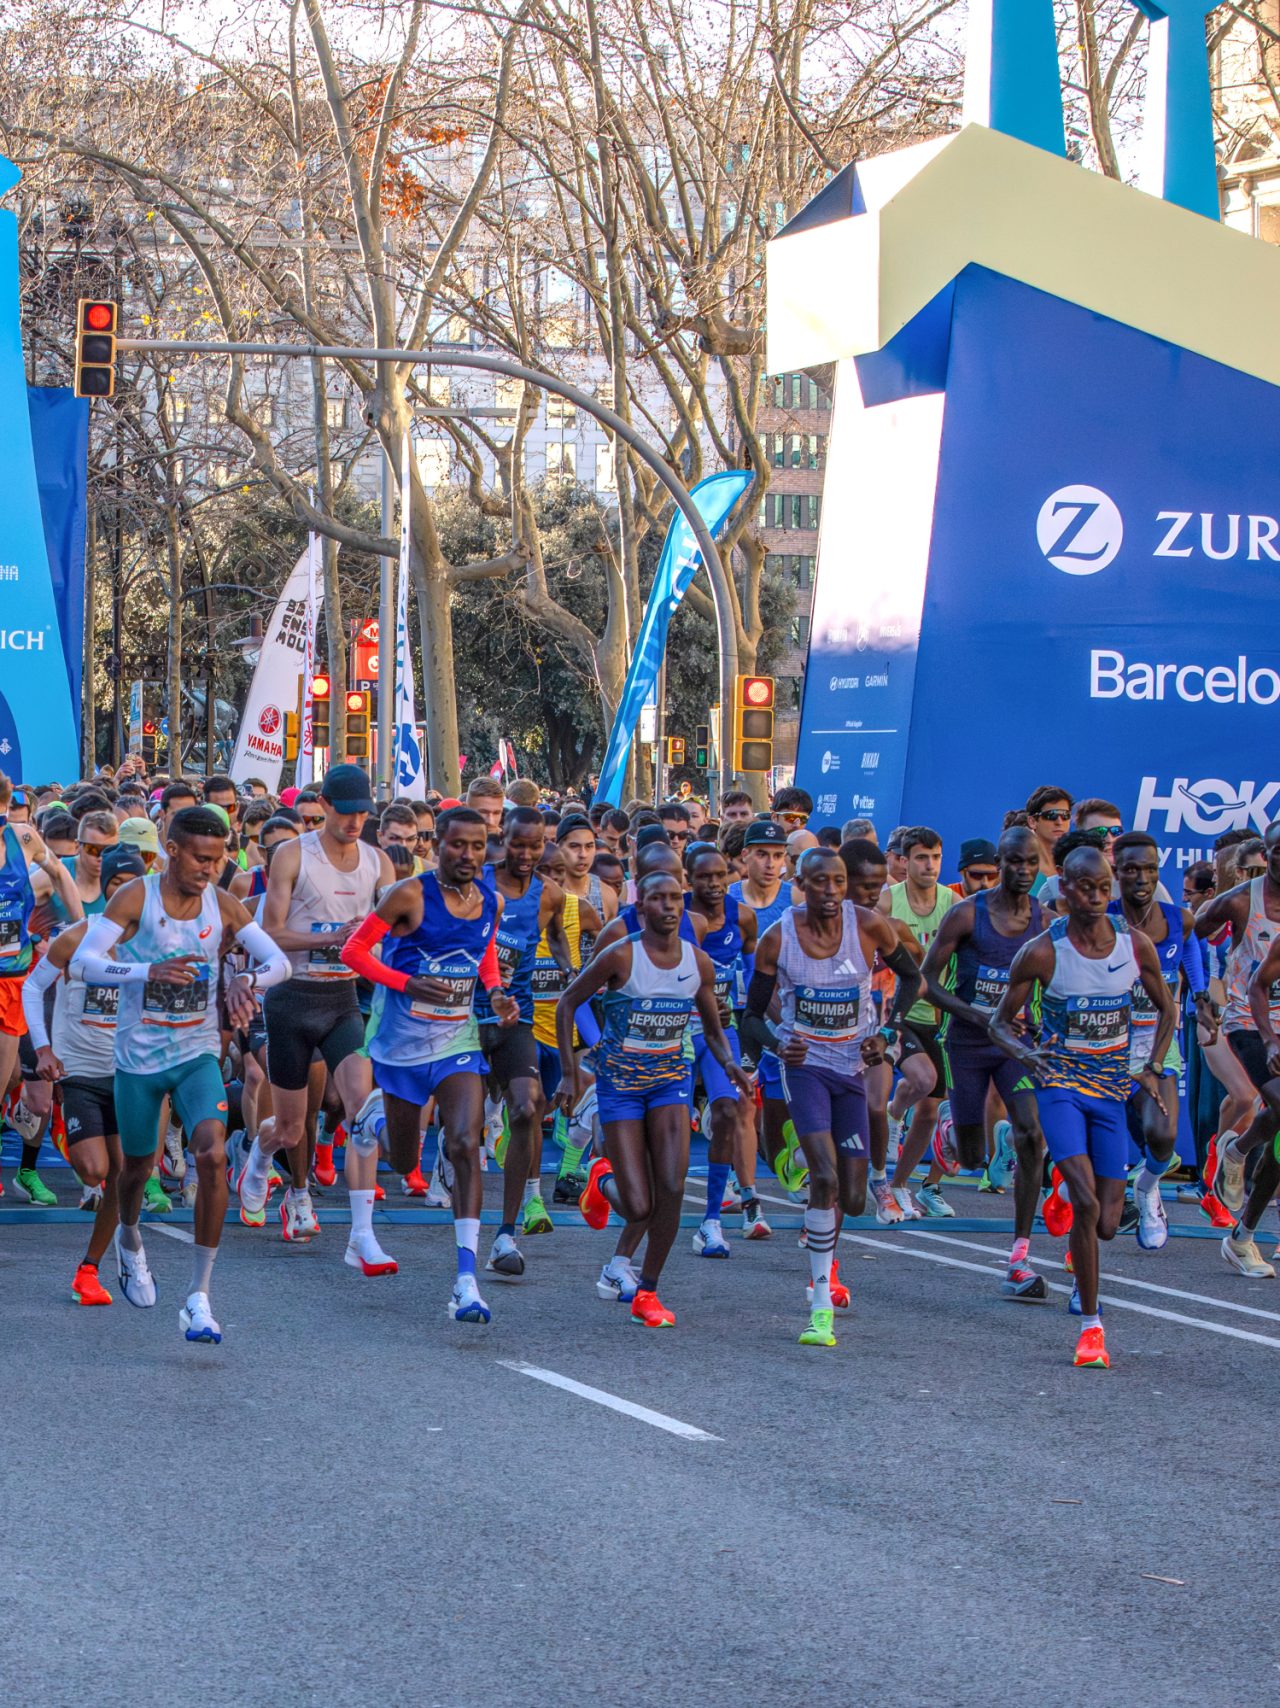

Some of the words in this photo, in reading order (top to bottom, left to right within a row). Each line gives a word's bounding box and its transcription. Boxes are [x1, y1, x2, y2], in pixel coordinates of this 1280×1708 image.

[248, 734, 282, 757] YAMAHA
[1132, 776, 1280, 836] HOK
[497, 933, 518, 946] URICH
[443, 964, 471, 974] ZURICH
[531, 970, 559, 981] ACER
[818, 991, 850, 999] ZURICH
[112, 1002, 118, 1010] 2
[655, 1001, 684, 1009] ZURICH
[799, 1000, 854, 1016] CHUMBA
[1092, 998, 1123, 1008] ZURICH
[628, 1013, 689, 1027] JEPKOSGEI
[824, 1017, 834, 1025] 12
[1079, 1012, 1120, 1026] PACER
